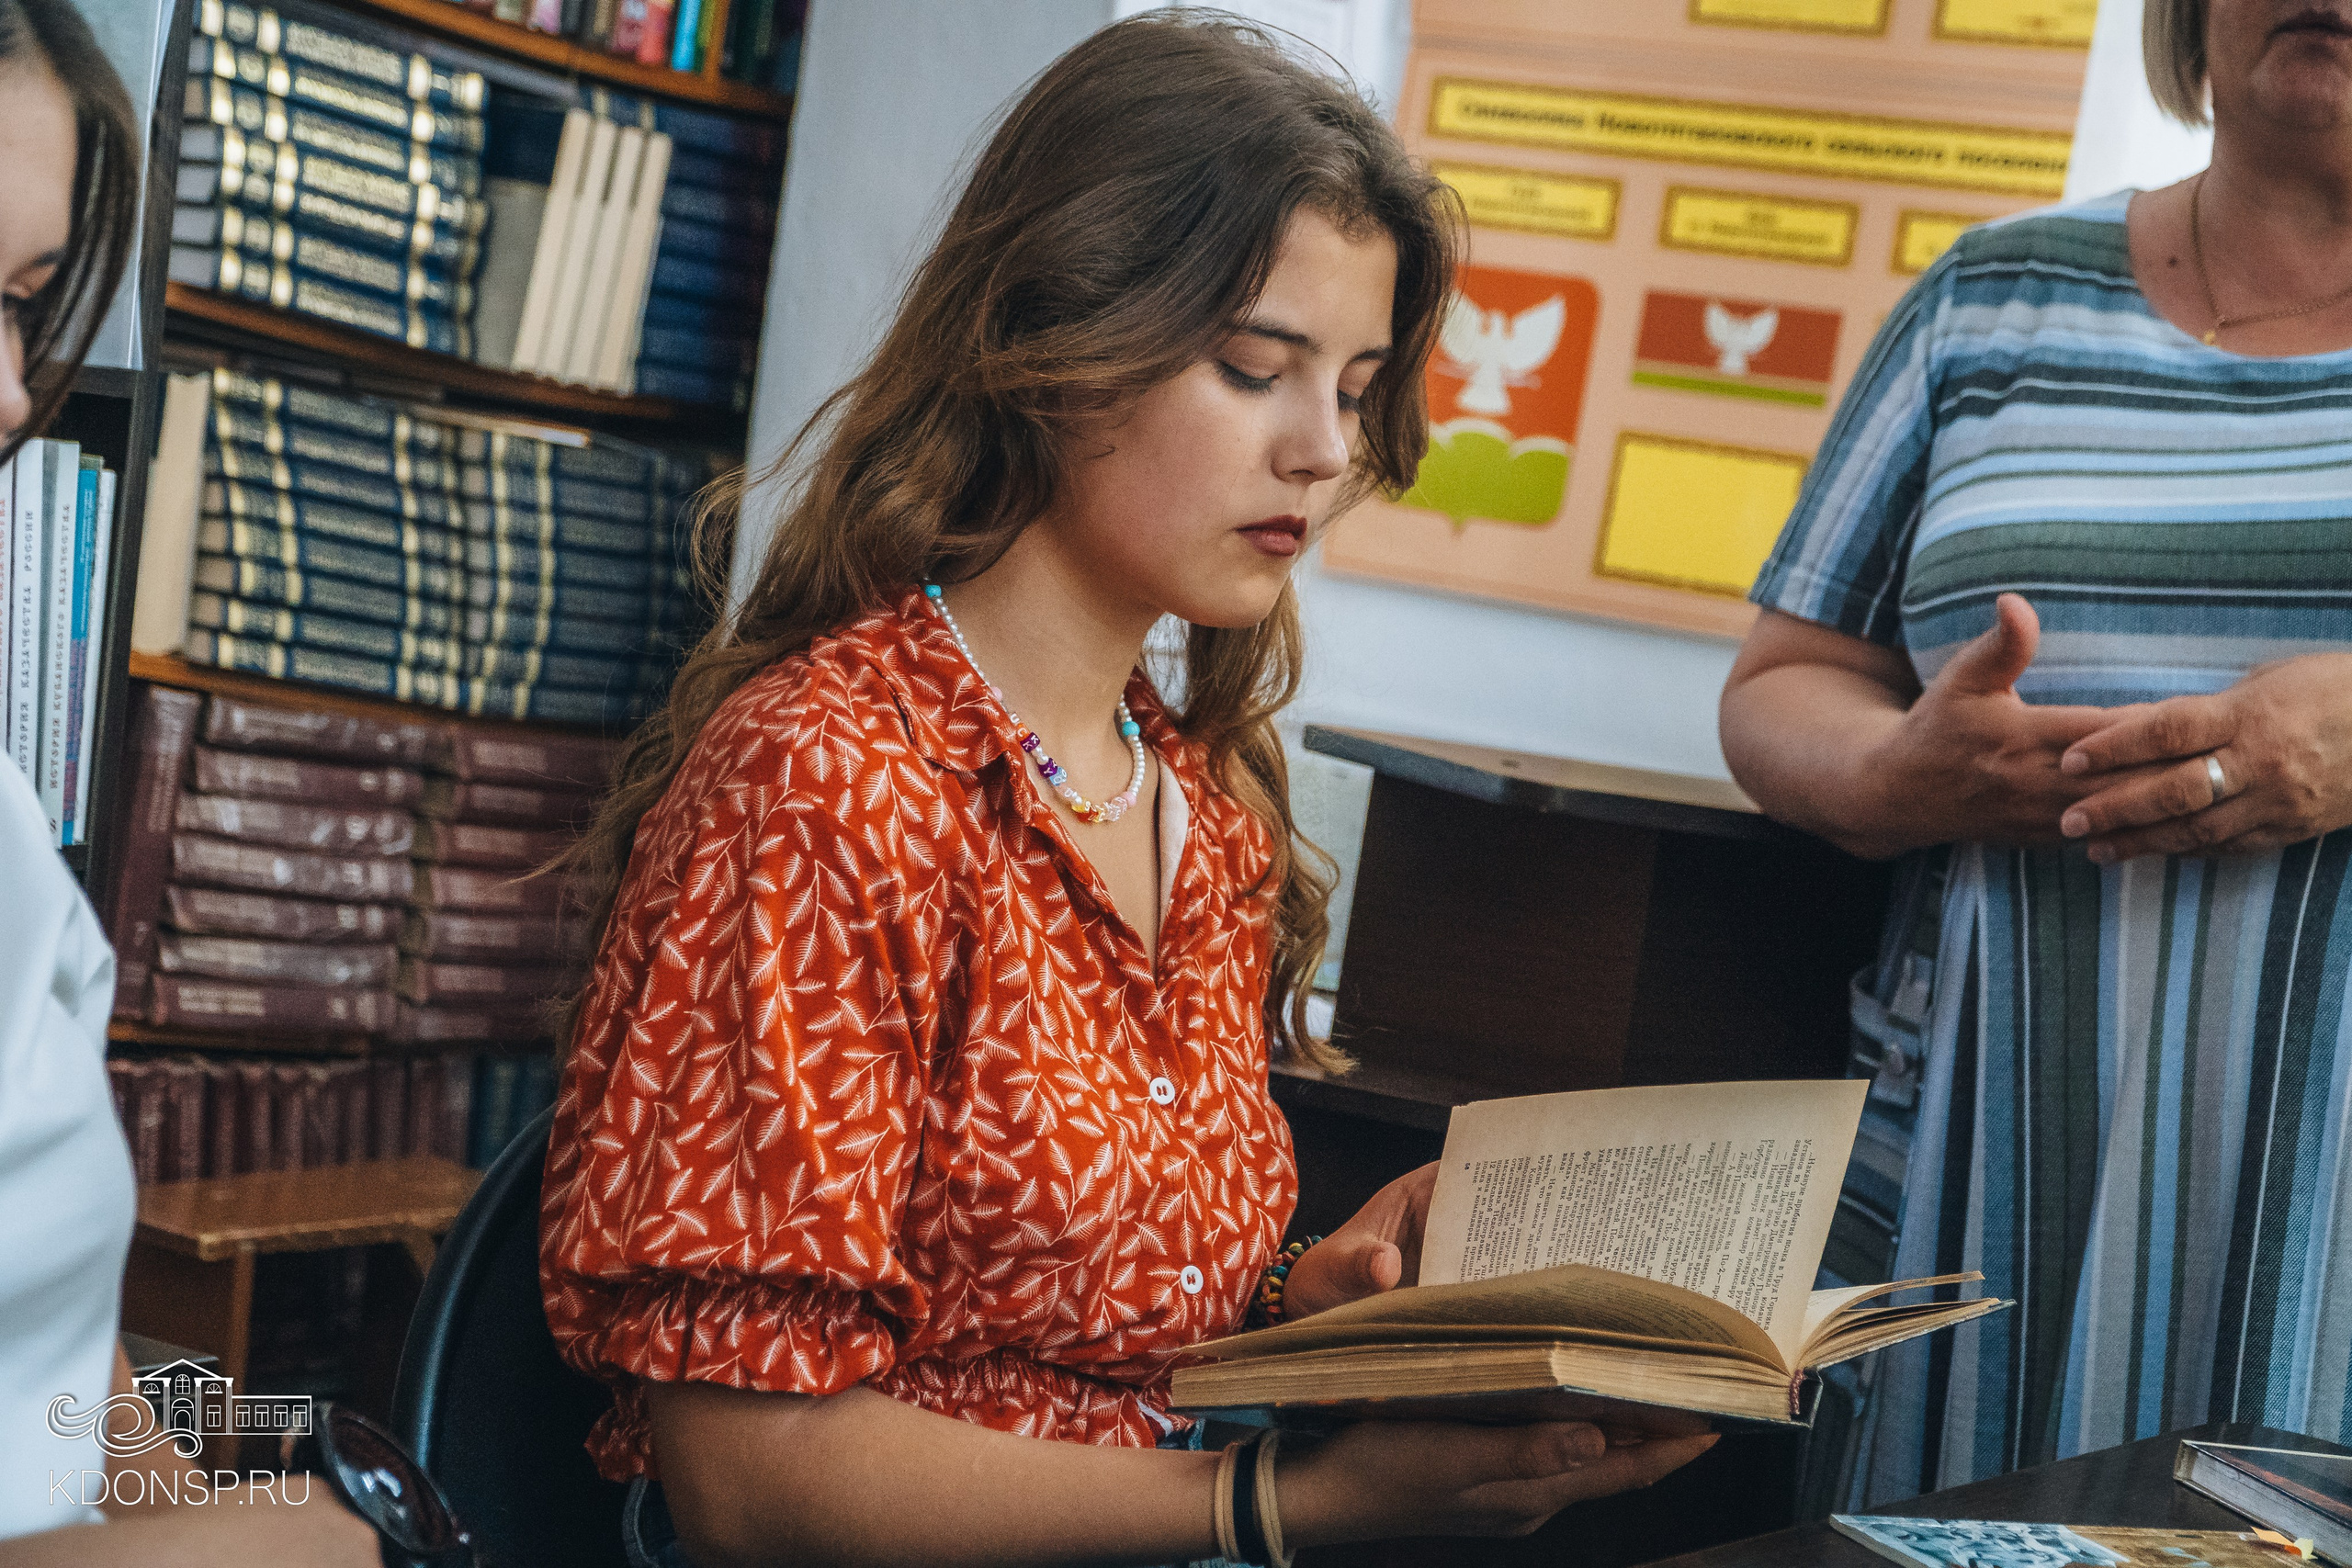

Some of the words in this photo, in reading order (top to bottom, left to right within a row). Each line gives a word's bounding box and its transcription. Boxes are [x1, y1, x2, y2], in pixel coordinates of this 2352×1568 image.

[1513, 1156, 1524, 1173] ров,
[1578, 1150, 1592, 1174] фронт
[1590, 1148, 1605, 1185] удалился
[1617, 1145, 1636, 1194] настроением
[1630, 1145, 1645, 1181] стоянием
[1642, 1145, 1654, 1166] были
[1659, 1143, 1676, 1190] тественным.
[1679, 1142, 1691, 1168] чонок,
[1757, 1139, 1775, 1179] радованно
[1781, 1138, 1802, 1188] авиадивизии
[1796, 1138, 1812, 1169] Устинов
[1478, 1160, 1488, 1183] полка
[1483, 1172, 1493, 1192] июня
[1486, 1158, 1504, 1212] полнительной
[1503, 1157, 1517, 1199] отыскание
[1510, 1156, 1531, 1218] дополнительные
[1564, 1163, 1581, 1201] Комиссар
[1609, 1162, 1624, 1204] сложилось
[1640, 1172, 1656, 1199] другой
[1648, 1144, 1668, 1197] авиационного
[1659, 1155, 1681, 1213] Разочарование
[1679, 1166, 1695, 1199] Дожили
[1703, 1165, 1720, 1195] Ничего,
[1720, 1173, 1732, 1200] нельзя
[1765, 1164, 1779, 1189] Новый
[1768, 1163, 1787, 1203] Принимай
[1506, 1177, 1520, 1207] посадка
[1516, 1168, 1536, 1224] Командование
[1540, 1191, 1552, 1220] вешать
[1581, 1179, 1593, 1200] были
[1589, 1169, 1608, 1218] провинность
[1599, 1180, 1613, 1213] восторге
[1681, 1181, 1698, 1218] медленно
[1727, 1175, 1741, 1203] Попова
[1732, 1181, 1747, 1214] женский
[1748, 1182, 1763, 1212] шепнул
[1758, 1194, 1769, 1212] полк
[1784, 1190, 1798, 1214] штаба
[1464, 1194, 1481, 1242] командирам
[1486, 1210, 1500, 1239] Недели
[1497, 1201, 1508, 1226] своего
[1531, 1201, 1542, 1229] можем
[1549, 1203, 1564, 1241] называли
[1559, 1205, 1570, 1228] полка
[1610, 1197, 1625, 1224] людей.
[1615, 1184, 1636, 1239] материальной
[1634, 1202, 1646, 1220] день
[1647, 1193, 1665, 1228] Мировая
[1688, 1196, 1702, 1227] привела
[1763, 1209, 1774, 1228] полк
[1770, 1190, 1789, 1226] Дмитрию
[1785, 1198, 1804, 1236] прибытия
[1471, 1209, 1485, 1242] дивизии
[1559, 1200, 1580, 1258] недружелюбно
[1566, 1202, 1586, 1254] встревожены
[1580, 1222, 1596, 1258] наградил
[1595, 1206, 1614, 1257] впечатление,
[1605, 1227, 1618, 1253] После
[1647, 1218, 1665, 1260] командира
[1661, 1222, 1673, 1244] По-2.
[1674, 1220, 1689, 1255] положил
[1695, 1213, 1713, 1259] подчинении
[1705, 1217, 1721, 1251] товарищ
[1726, 1218, 1736, 1236] полк
[1737, 1216, 1755, 1254] командир
[1750, 1217, 1765, 1239] дают!
[1774, 1219, 1788, 1243] армии
[1486, 1231, 1501, 1273] аэродрома
[1509, 1226, 1522, 1259] дивизии
[1521, 1233, 1535, 1264] драться
[1624, 1224, 1641, 1261] командир
[1629, 1229, 1646, 1274] состоящего
[1639, 1236, 1653, 1269] военная
[1754, 1233, 1768, 1261] ночных
[1756, 1228, 1779, 1281] Дмитриевичу
[1780, 1238, 1792, 1262] полка
[1464, 1245, 1477, 1276] пришел
[1738, 1251, 1754, 1284] прикрыв
[1764, 1251, 1780, 1287] позвонил
[1725, 1258, 1744, 1301] комиссару
[1770, 1273, 1784, 1293] Труд
[1747, 1284, 1764, 1317] Попову:
[1760, 1295, 1778, 1332] Горняка
